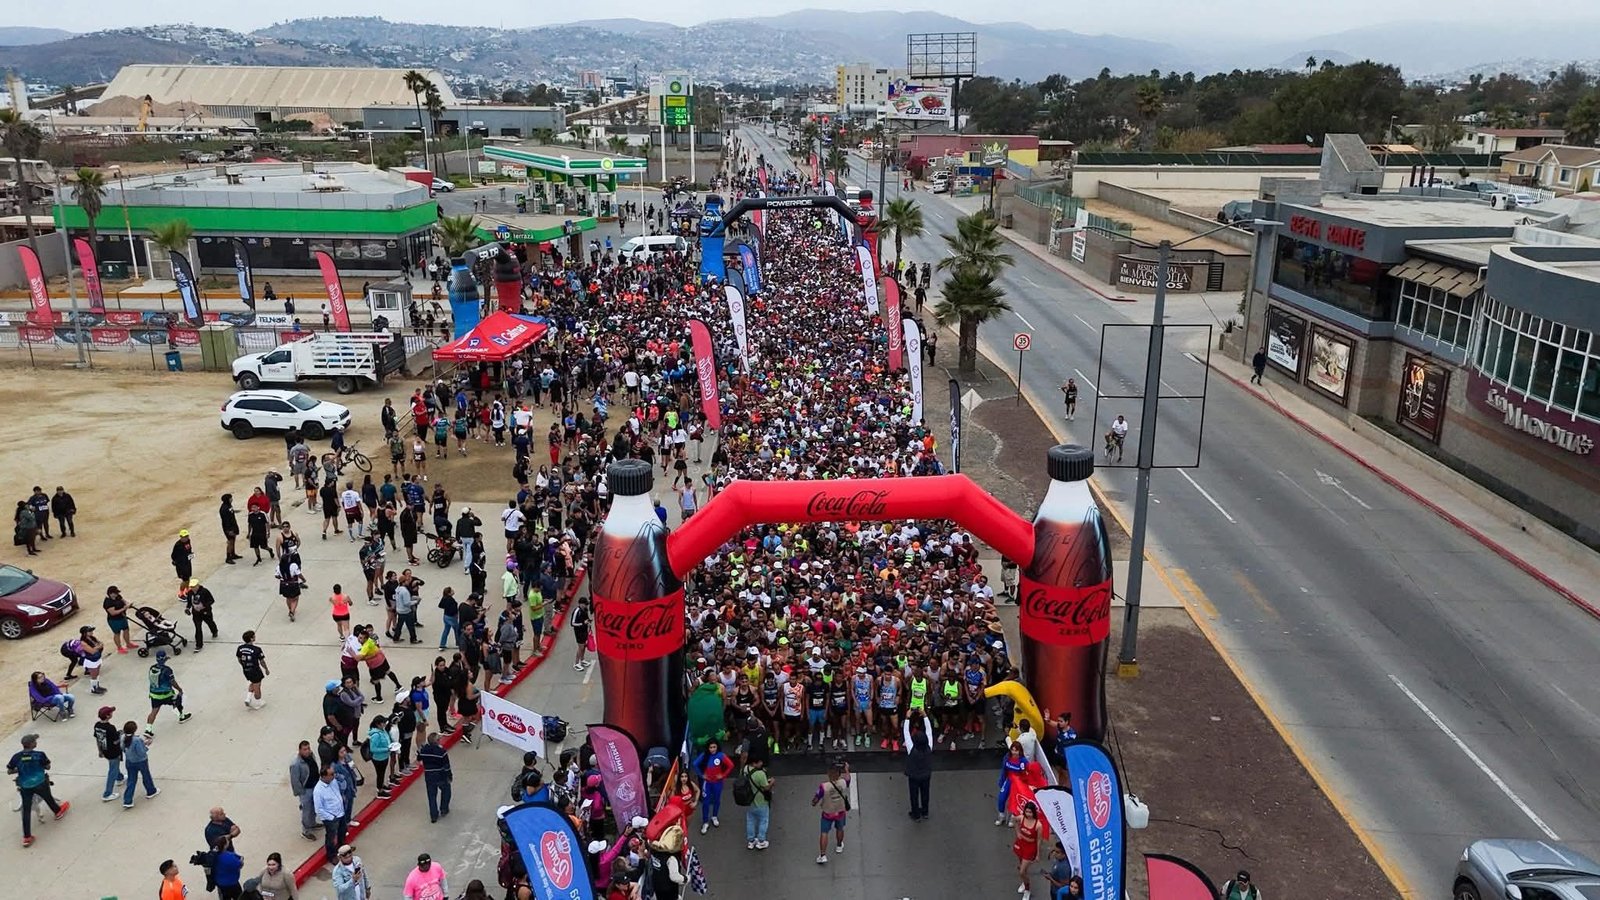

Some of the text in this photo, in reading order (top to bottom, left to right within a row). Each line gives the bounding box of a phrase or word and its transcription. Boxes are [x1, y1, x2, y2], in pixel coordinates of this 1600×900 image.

[766, 199, 813, 207] POWERADE
[513, 232, 534, 240] terraza
[1137, 263, 1178, 273] RESIDEIAL
[1120, 275, 1184, 289] BIENVENIOS
[1018, 337, 1027, 345] 35
[807, 490, 890, 517] Coca-Cola
[1058, 627, 1089, 635] ZERO
[501, 714, 523, 731] Roma
